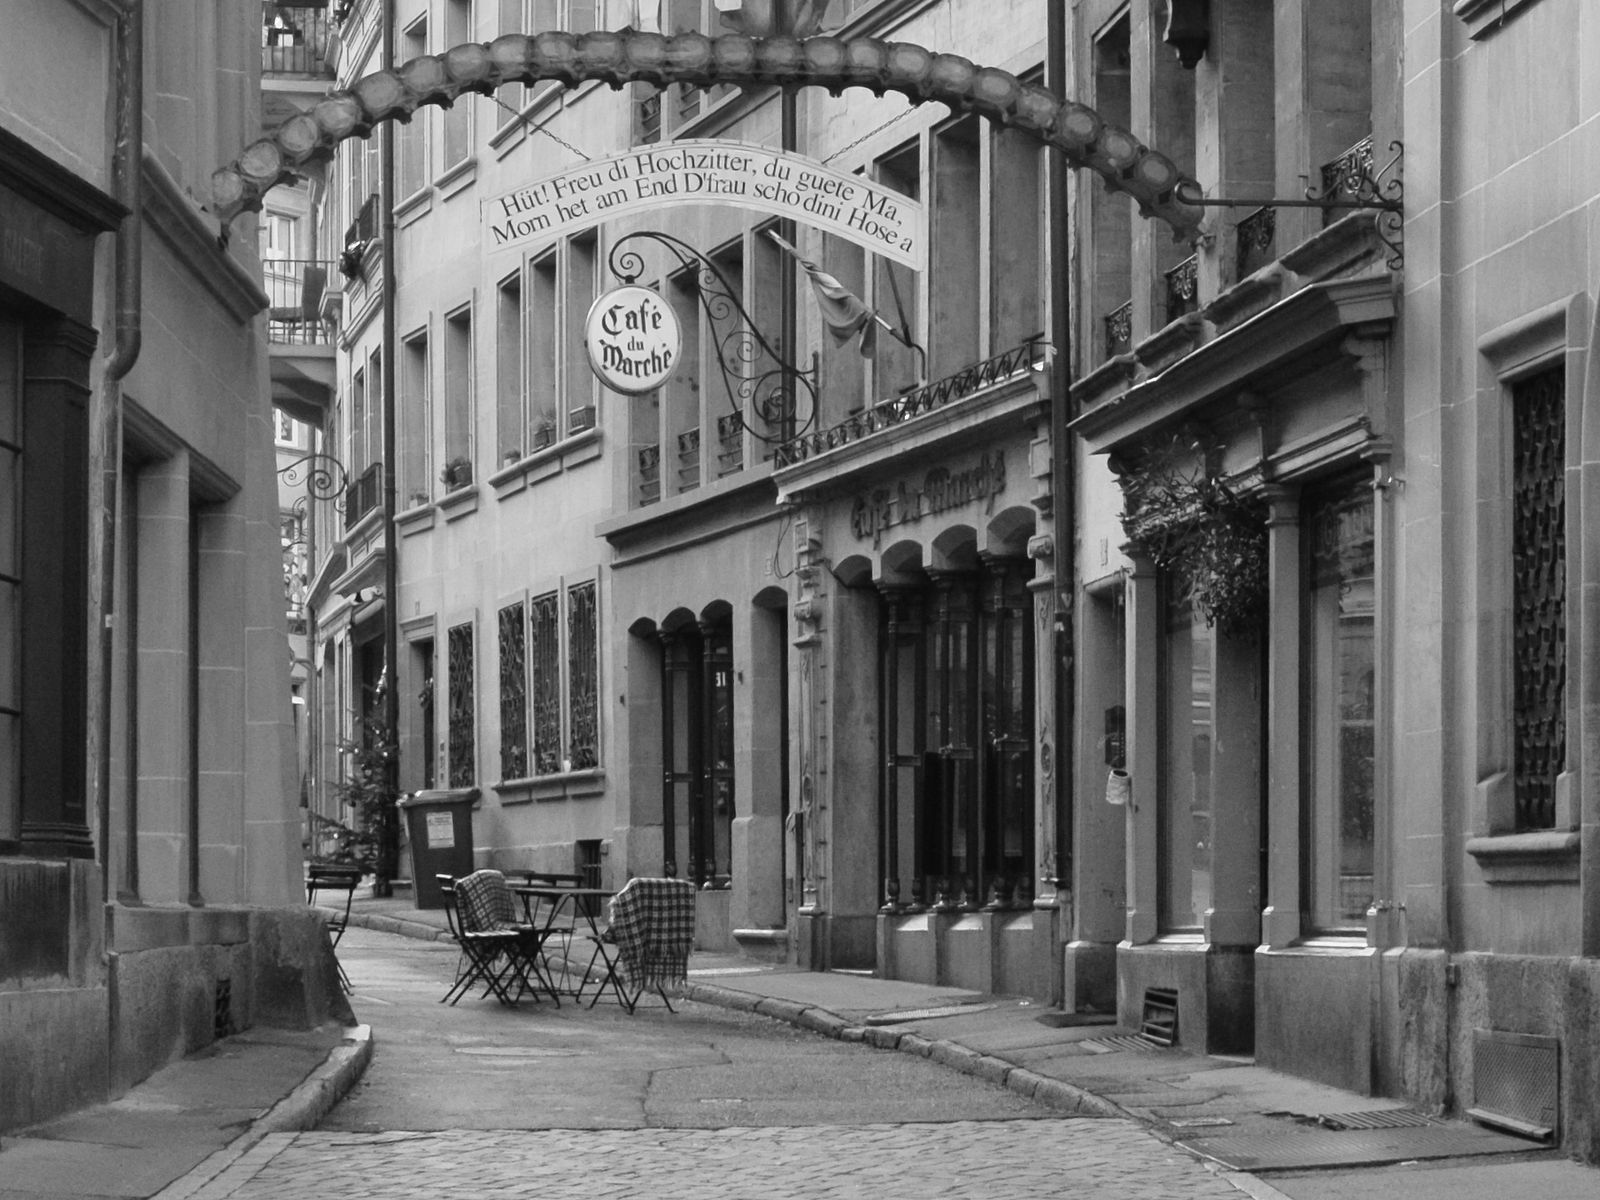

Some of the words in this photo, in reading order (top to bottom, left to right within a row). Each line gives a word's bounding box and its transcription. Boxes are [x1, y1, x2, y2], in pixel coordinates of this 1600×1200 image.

[499, 184, 550, 218] Hüt!
[551, 176, 603, 200] Freu
[608, 159, 630, 182] di
[635, 149, 757, 175] Hochzitter,
[763, 157, 791, 181] du
[795, 171, 855, 201] guete
[862, 189, 903, 226] Ma,
[492, 213, 552, 245] Morn
[555, 198, 590, 223] het
[595, 188, 629, 210] am
[634, 173, 678, 199] End
[684, 171, 747, 195] D'frau
[753, 182, 801, 206] scho
[803, 193, 844, 221] dini
[847, 206, 898, 245] Hose
[899, 238, 914, 253] a
[601, 297, 662, 338] Café
[598, 338, 673, 379] Marché
[627, 335, 645, 352] du
